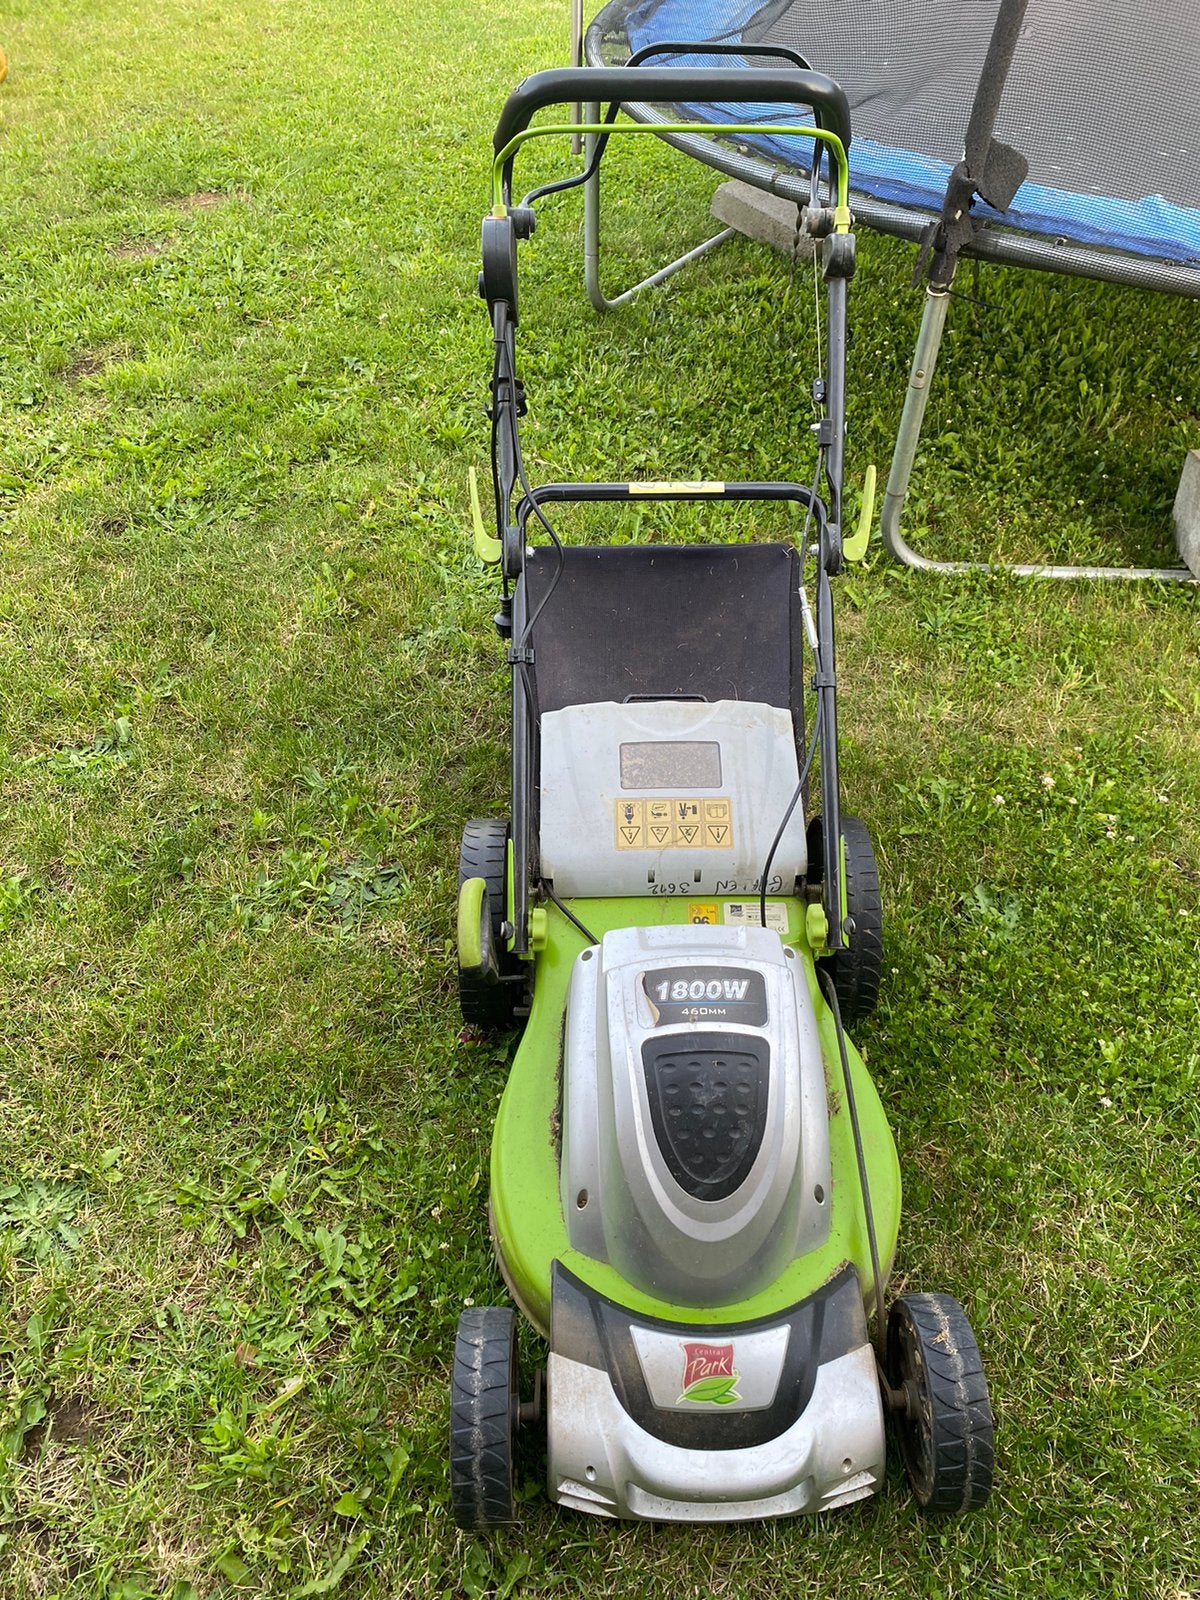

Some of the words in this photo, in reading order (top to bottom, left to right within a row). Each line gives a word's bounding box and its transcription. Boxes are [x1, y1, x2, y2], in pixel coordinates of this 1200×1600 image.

[655, 979, 751, 1001] 1800W
[681, 1007, 727, 1016] 460MM
[694, 1348, 725, 1356] Central
[687, 1356, 731, 1382] Park
